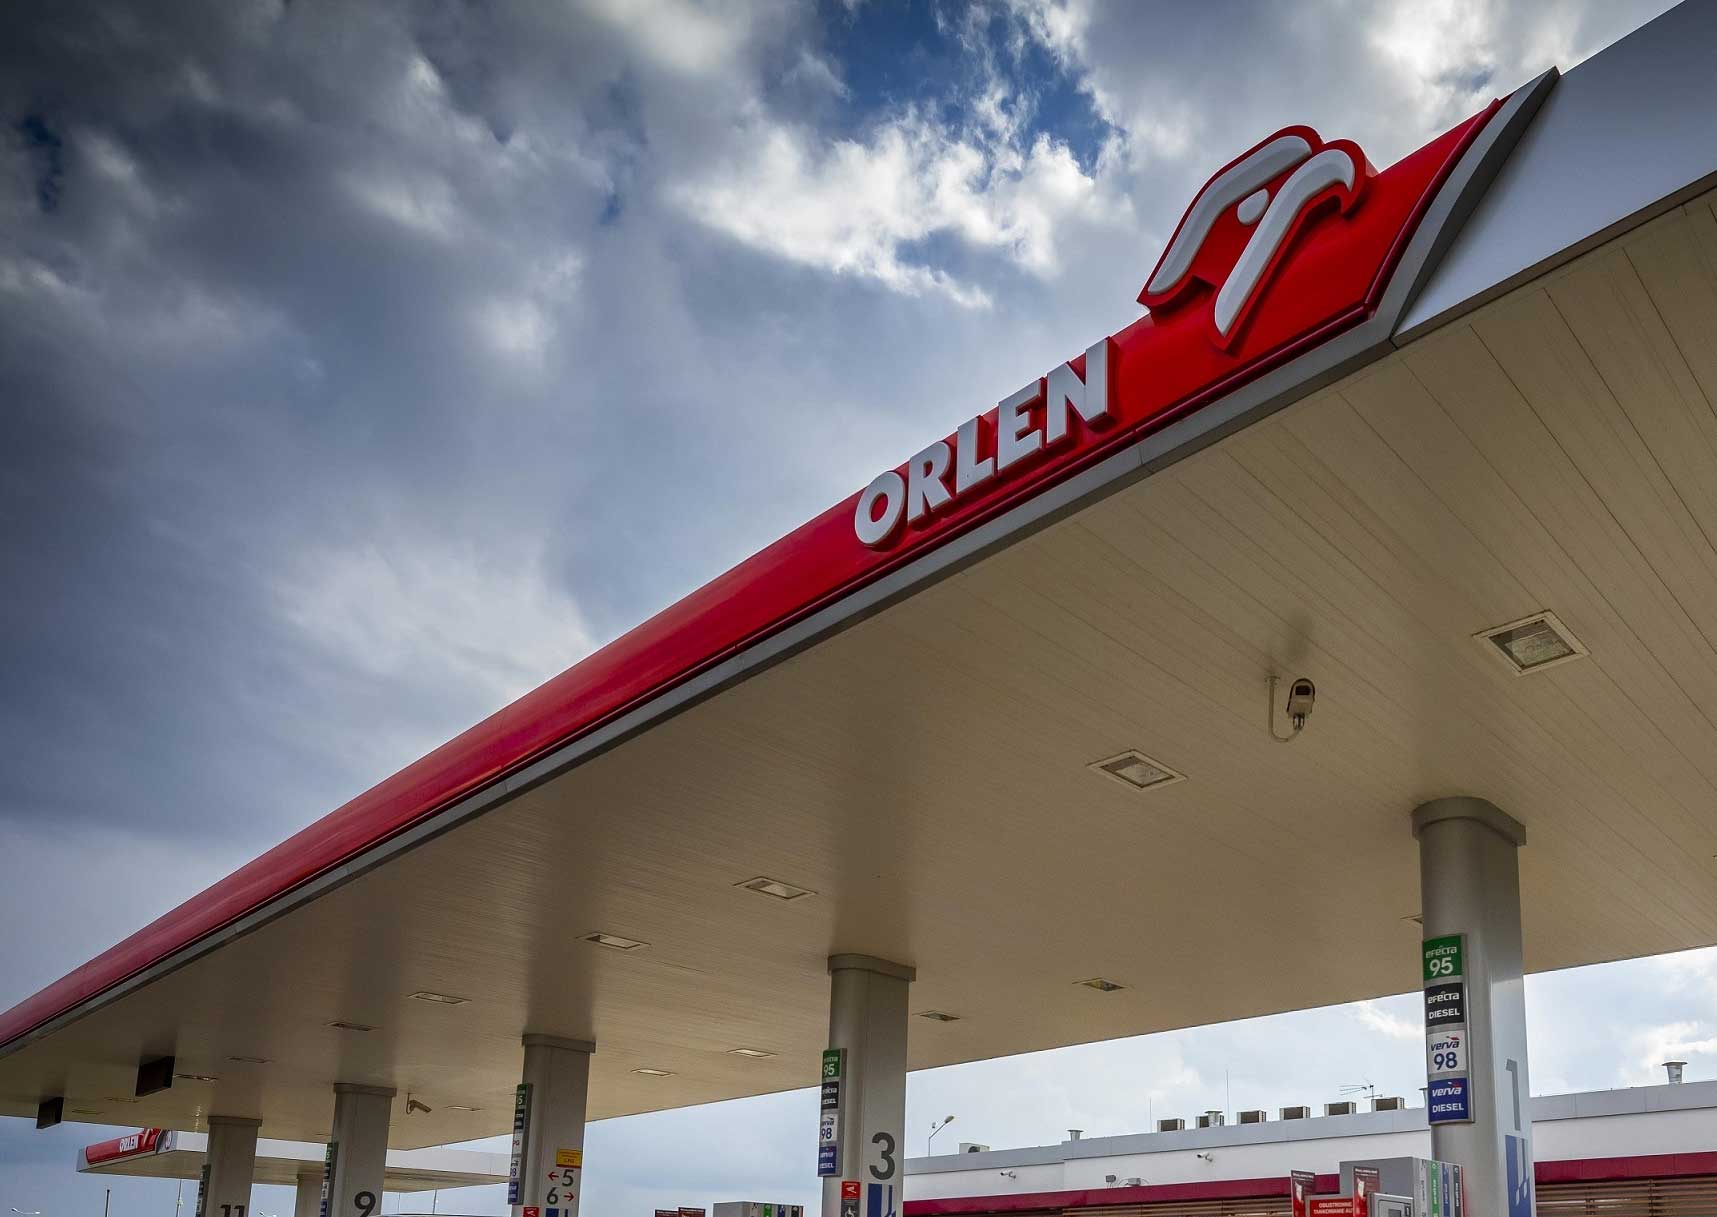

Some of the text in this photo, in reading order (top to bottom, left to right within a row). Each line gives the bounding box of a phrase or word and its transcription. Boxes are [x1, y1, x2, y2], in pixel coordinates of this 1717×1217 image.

[854, 336, 1109, 547] ORLEN
[1429, 957, 1454, 976] 95
[1429, 1008, 1460, 1019] DIESEL
[1430, 1040, 1460, 1051] verva
[823, 1064, 835, 1076] 95
[1433, 1052, 1457, 1070] 98
[1432, 1086, 1463, 1097] verva
[1506, 1058, 1521, 1131] 1
[1432, 1103, 1465, 1113] DIESEL
[821, 1127, 833, 1140] 98
[869, 1131, 896, 1181] 3
[561, 1168, 575, 1187] 5
[354, 1190, 377, 1217] 9
[546, 1186, 559, 1205] 6
